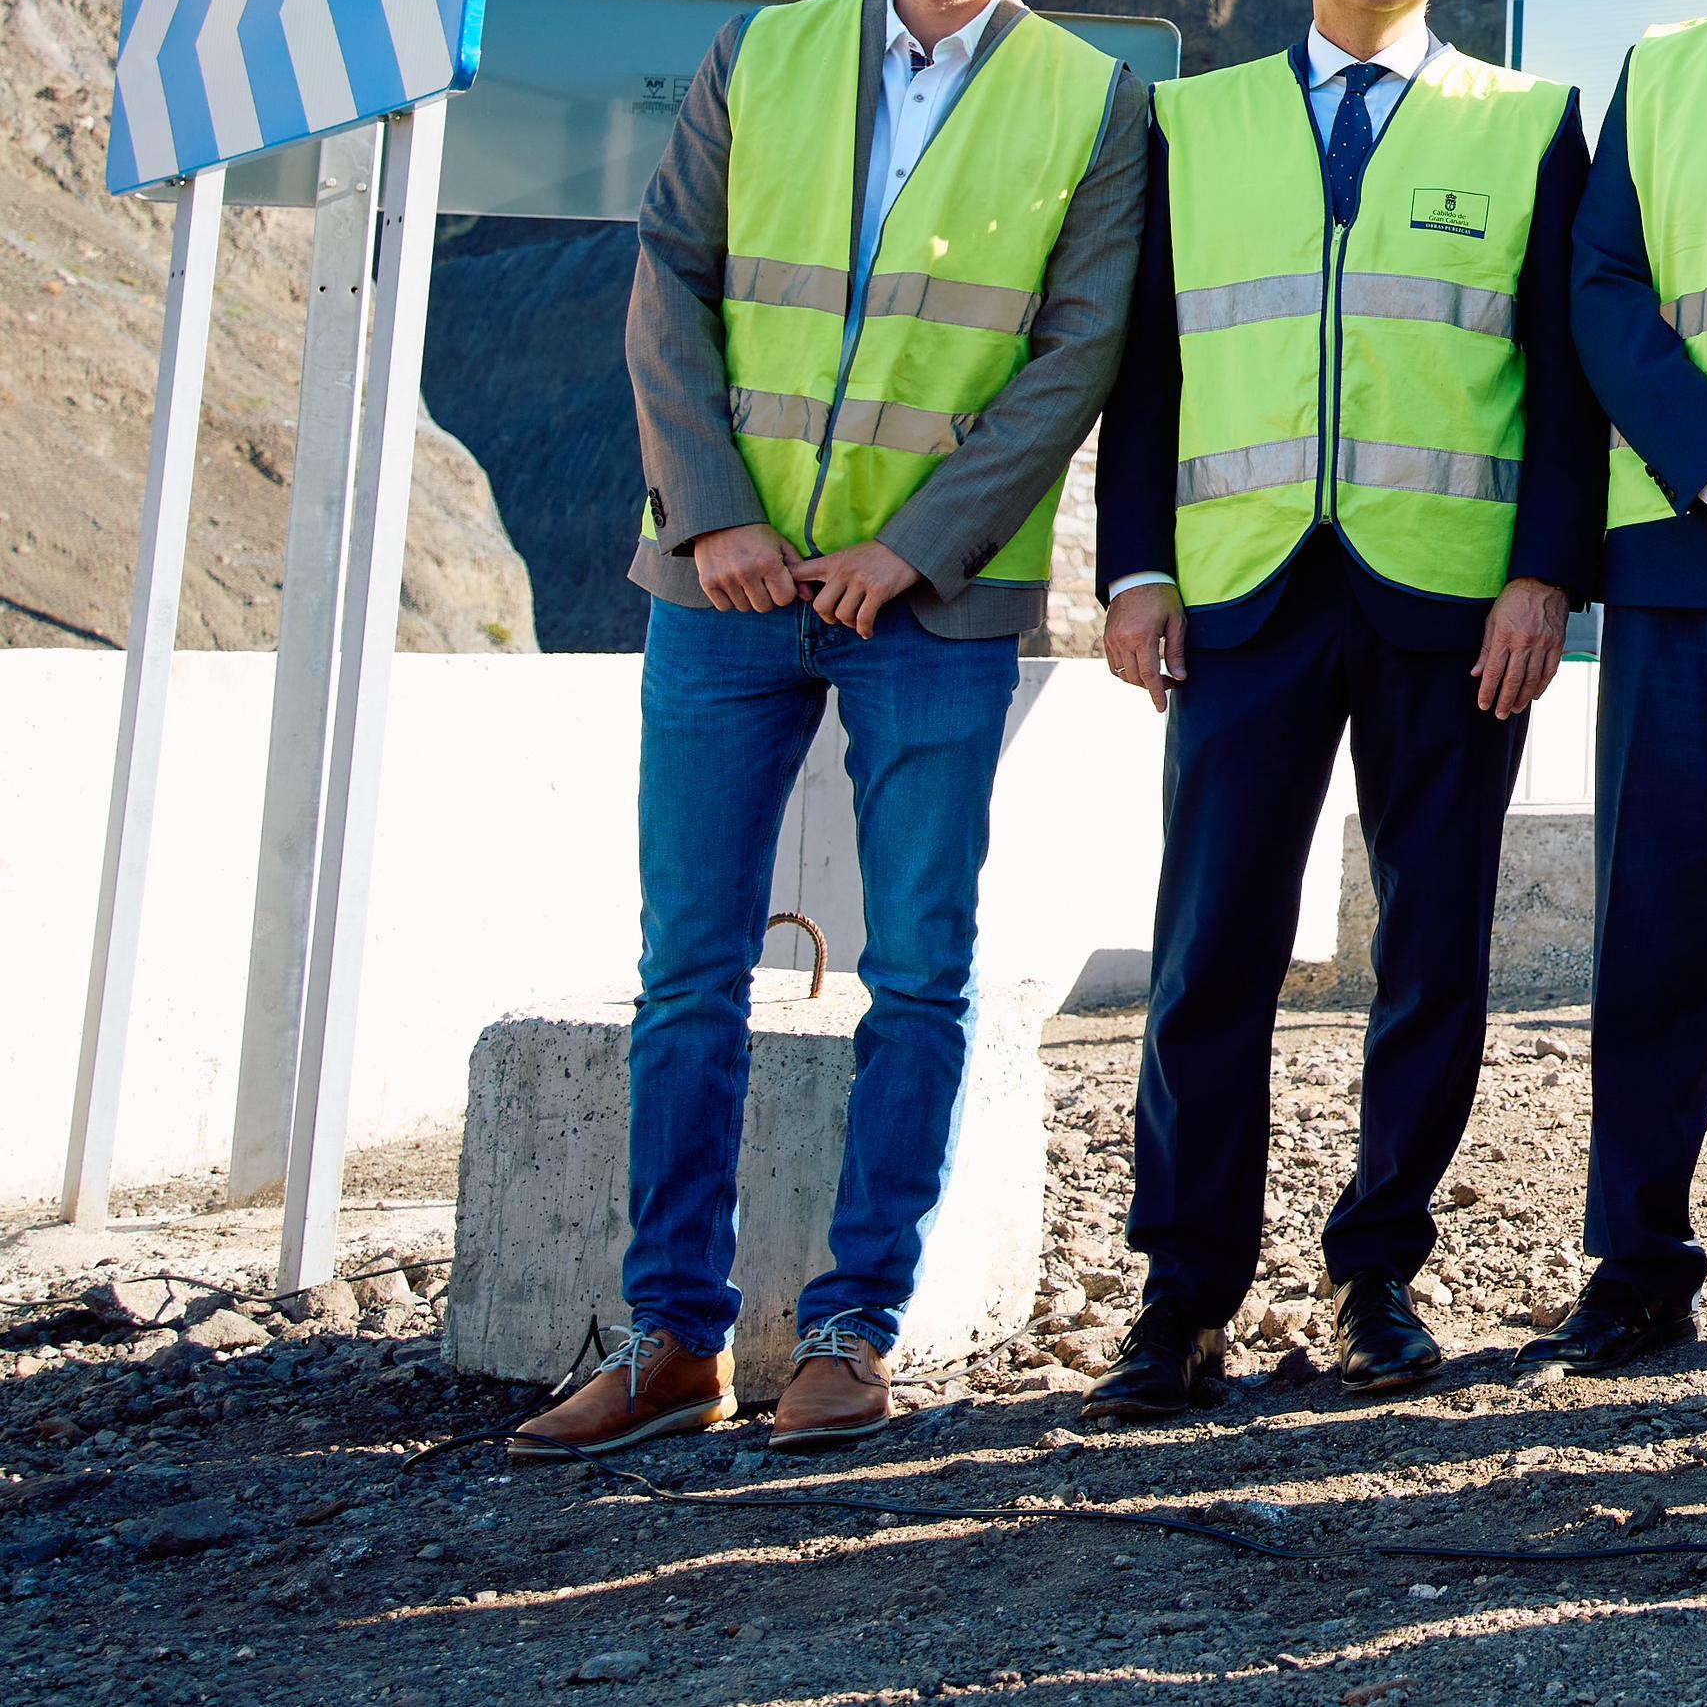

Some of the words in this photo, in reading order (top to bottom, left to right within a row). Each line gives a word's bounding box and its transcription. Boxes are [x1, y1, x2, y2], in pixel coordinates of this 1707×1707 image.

[645, 80, 664, 88] API
[1432, 209, 1457, 219] Cabildo
[1457, 212, 1467, 220] de
[1428, 215, 1444, 223] Gran
[1445, 217, 1469, 227] Canaria
